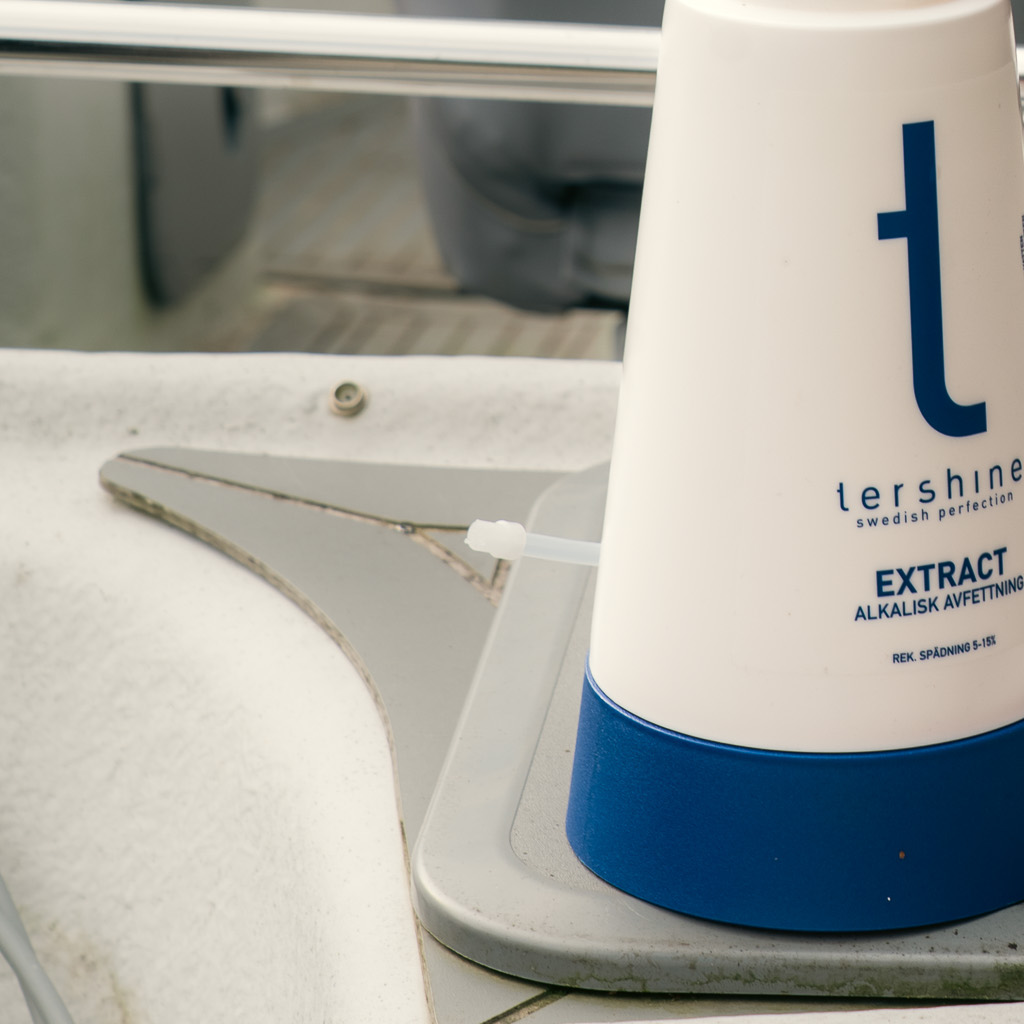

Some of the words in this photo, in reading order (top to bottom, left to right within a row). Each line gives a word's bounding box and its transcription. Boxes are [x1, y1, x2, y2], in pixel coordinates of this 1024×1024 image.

[837, 458, 1023, 511] tershine
[856, 508, 929, 528] swedish
[938, 490, 1014, 521] perfection
[875, 546, 1008, 598] EXTRACT
[854, 596, 940, 622] ALKALISK
[943, 574, 1024, 611] AVFETTNING
[892, 651, 917, 664] REK.
[919, 642, 971, 661] SPÄDNING
[972, 635, 997, 651] 5-15%
